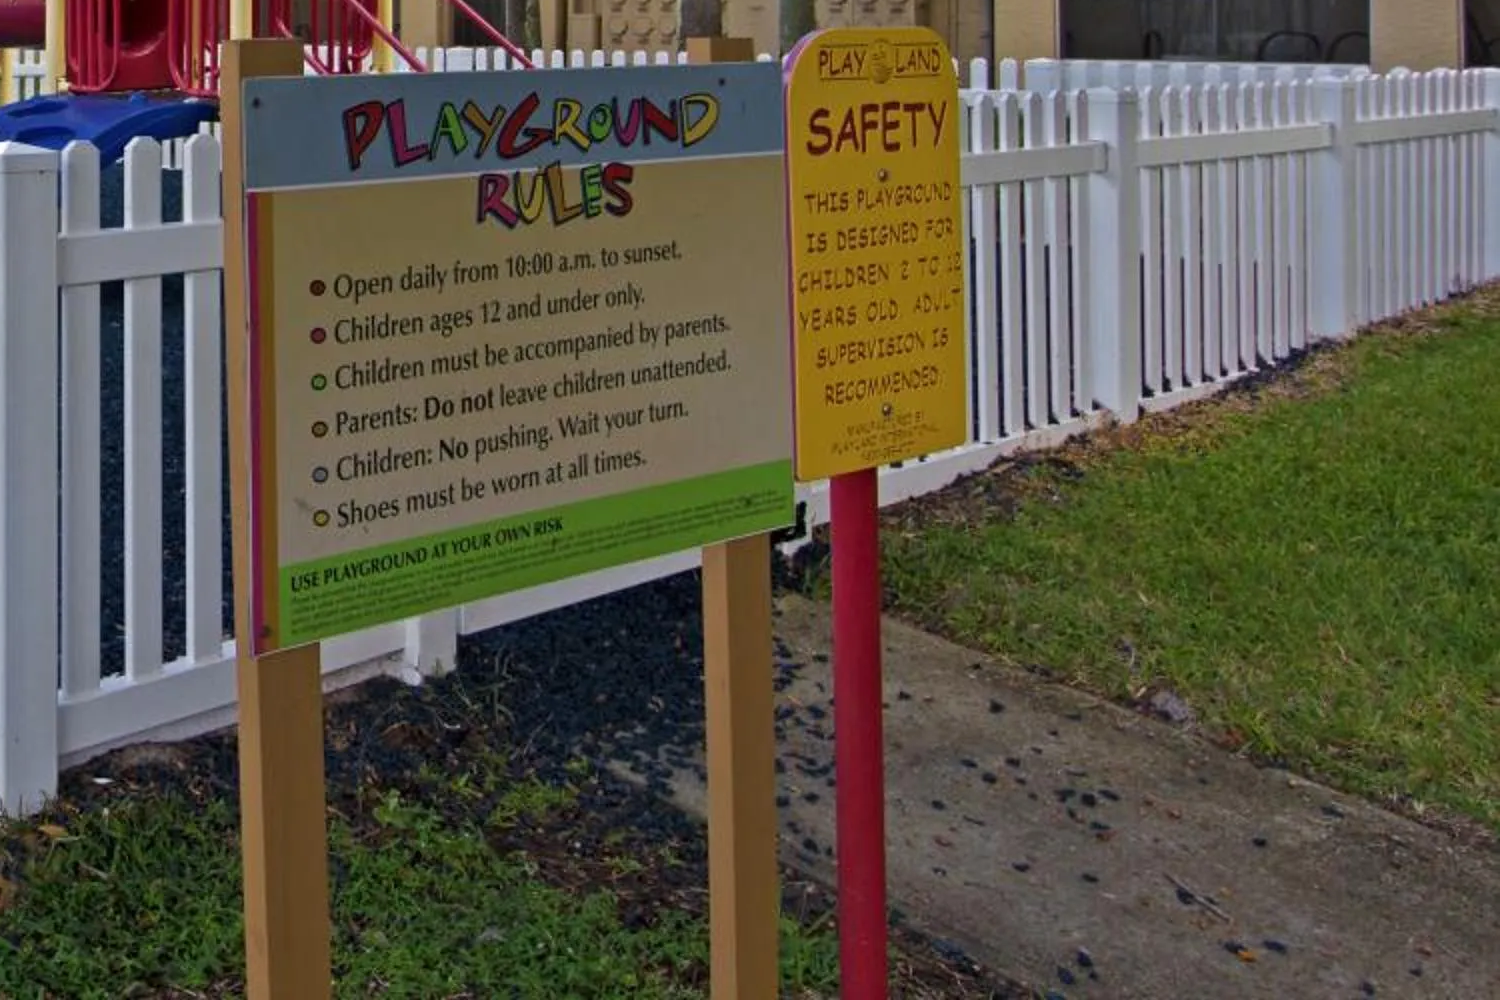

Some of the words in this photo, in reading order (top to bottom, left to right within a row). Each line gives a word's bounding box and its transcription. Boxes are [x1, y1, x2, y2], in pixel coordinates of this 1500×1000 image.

[819, 50, 867, 75] PLAY
[895, 48, 941, 73] LAND
[342, 91, 721, 170] PLAYGROUND
[806, 101, 947, 156] SAFETY
[476, 160, 635, 229] RULES
[804, 192, 849, 214] THIS
[857, 182, 951, 209] PLAYGROUND
[806, 232, 827, 253] IS
[837, 221, 919, 251] DESIGNED
[925, 218, 953, 239] FOR
[333, 274, 393, 304] Open
[400, 266, 448, 294] daily
[453, 260, 499, 284] from
[506, 252, 553, 278] 10:00
[559, 254, 596, 273] a.m.
[601, 247, 619, 269] to
[623, 240, 682, 265] sunset.
[799, 263, 889, 294] CHILDREN
[902, 260, 909, 280] 2
[918, 255, 939, 277] TO
[335, 313, 424, 344] Children
[430, 309, 473, 338] ages
[480, 300, 500, 324] 12
[507, 293, 541, 321] and
[547, 288, 600, 315] under
[605, 281, 645, 310] only.
[800, 305, 857, 331] YEARS
[335, 357, 424, 390] Children
[431, 349, 479, 375] must
[485, 344, 509, 367] be
[514, 321, 634, 362] accompanied
[639, 320, 660, 348] by
[665, 313, 731, 346] parents.
[816, 331, 924, 369] SUPERVISION
[933, 328, 949, 348] IS
[336, 403, 418, 436] Parents:
[424, 396, 454, 421] Do
[461, 388, 493, 415] not
[500, 383, 547, 408] leave
[554, 369, 625, 398] children
[631, 348, 732, 384] unattended.
[337, 447, 432, 481] Children:
[439, 437, 469, 462] No
[475, 424, 553, 464] pushing.
[558, 411, 600, 439] Wait
[604, 408, 645, 438] your
[649, 401, 689, 424] turn.
[337, 498, 400, 529] Shoes
[406, 490, 455, 514] must
[461, 477, 485, 501] be
[492, 469, 540, 496] worn
[546, 461, 564, 485] at
[568, 452, 589, 480] all
[595, 449, 647, 475] times.
[291, 570, 320, 592] USE
[324, 548, 428, 585] PLAYGROUND
[431, 542, 450, 560] AT
[451, 532, 492, 555] YOUR
[495, 521, 532, 544] OWN
[533, 516, 564, 535] RISK
